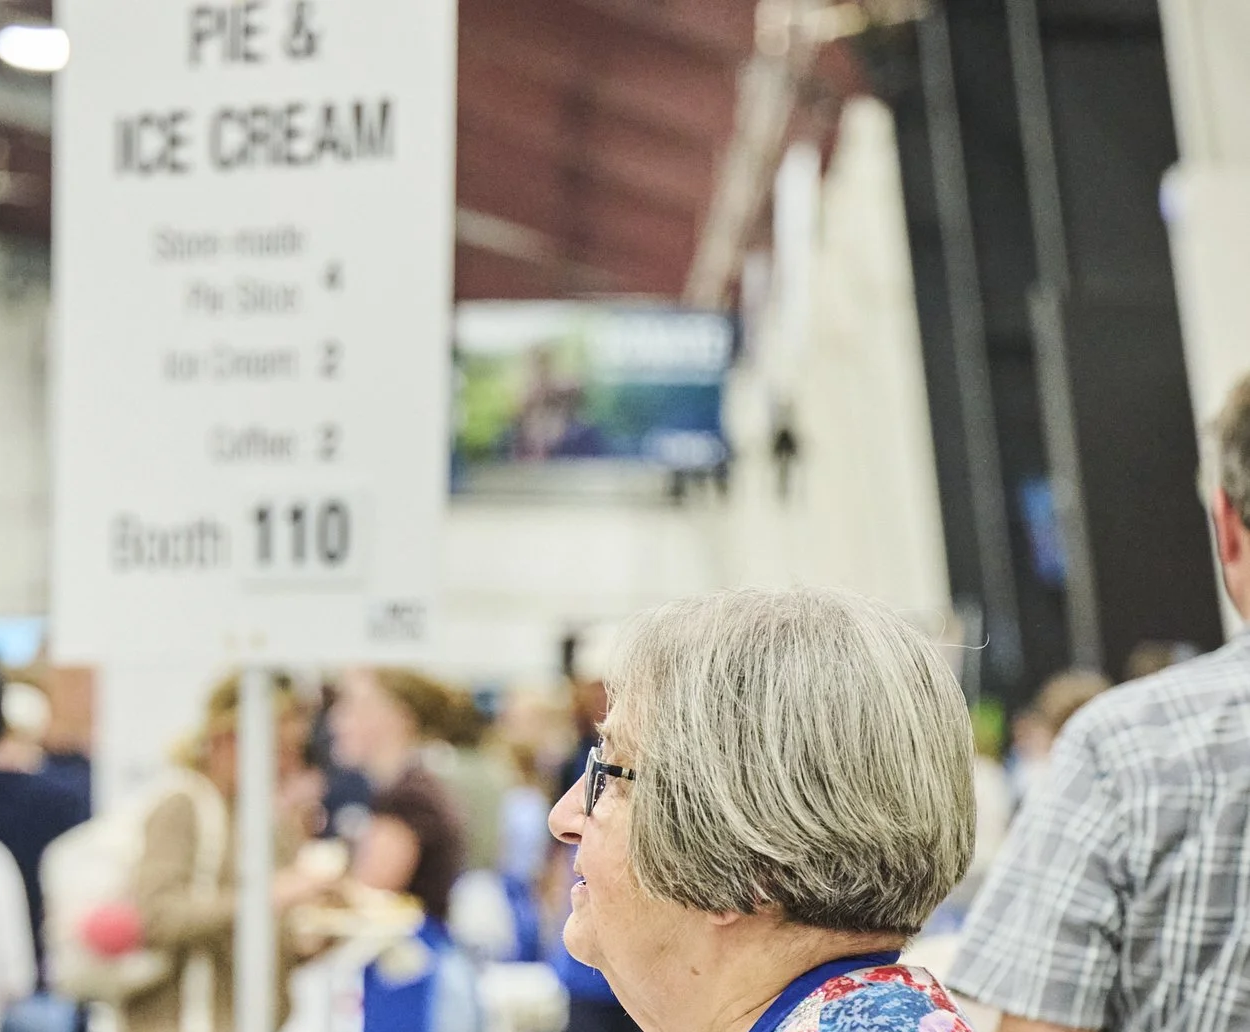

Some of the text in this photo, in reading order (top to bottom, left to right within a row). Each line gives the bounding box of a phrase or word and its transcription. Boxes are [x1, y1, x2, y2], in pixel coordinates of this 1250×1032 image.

[187, 0, 323, 70] PIE &
[115, 97, 395, 176] ICE CREAM
[112, 499, 351, 573] Booth 110
